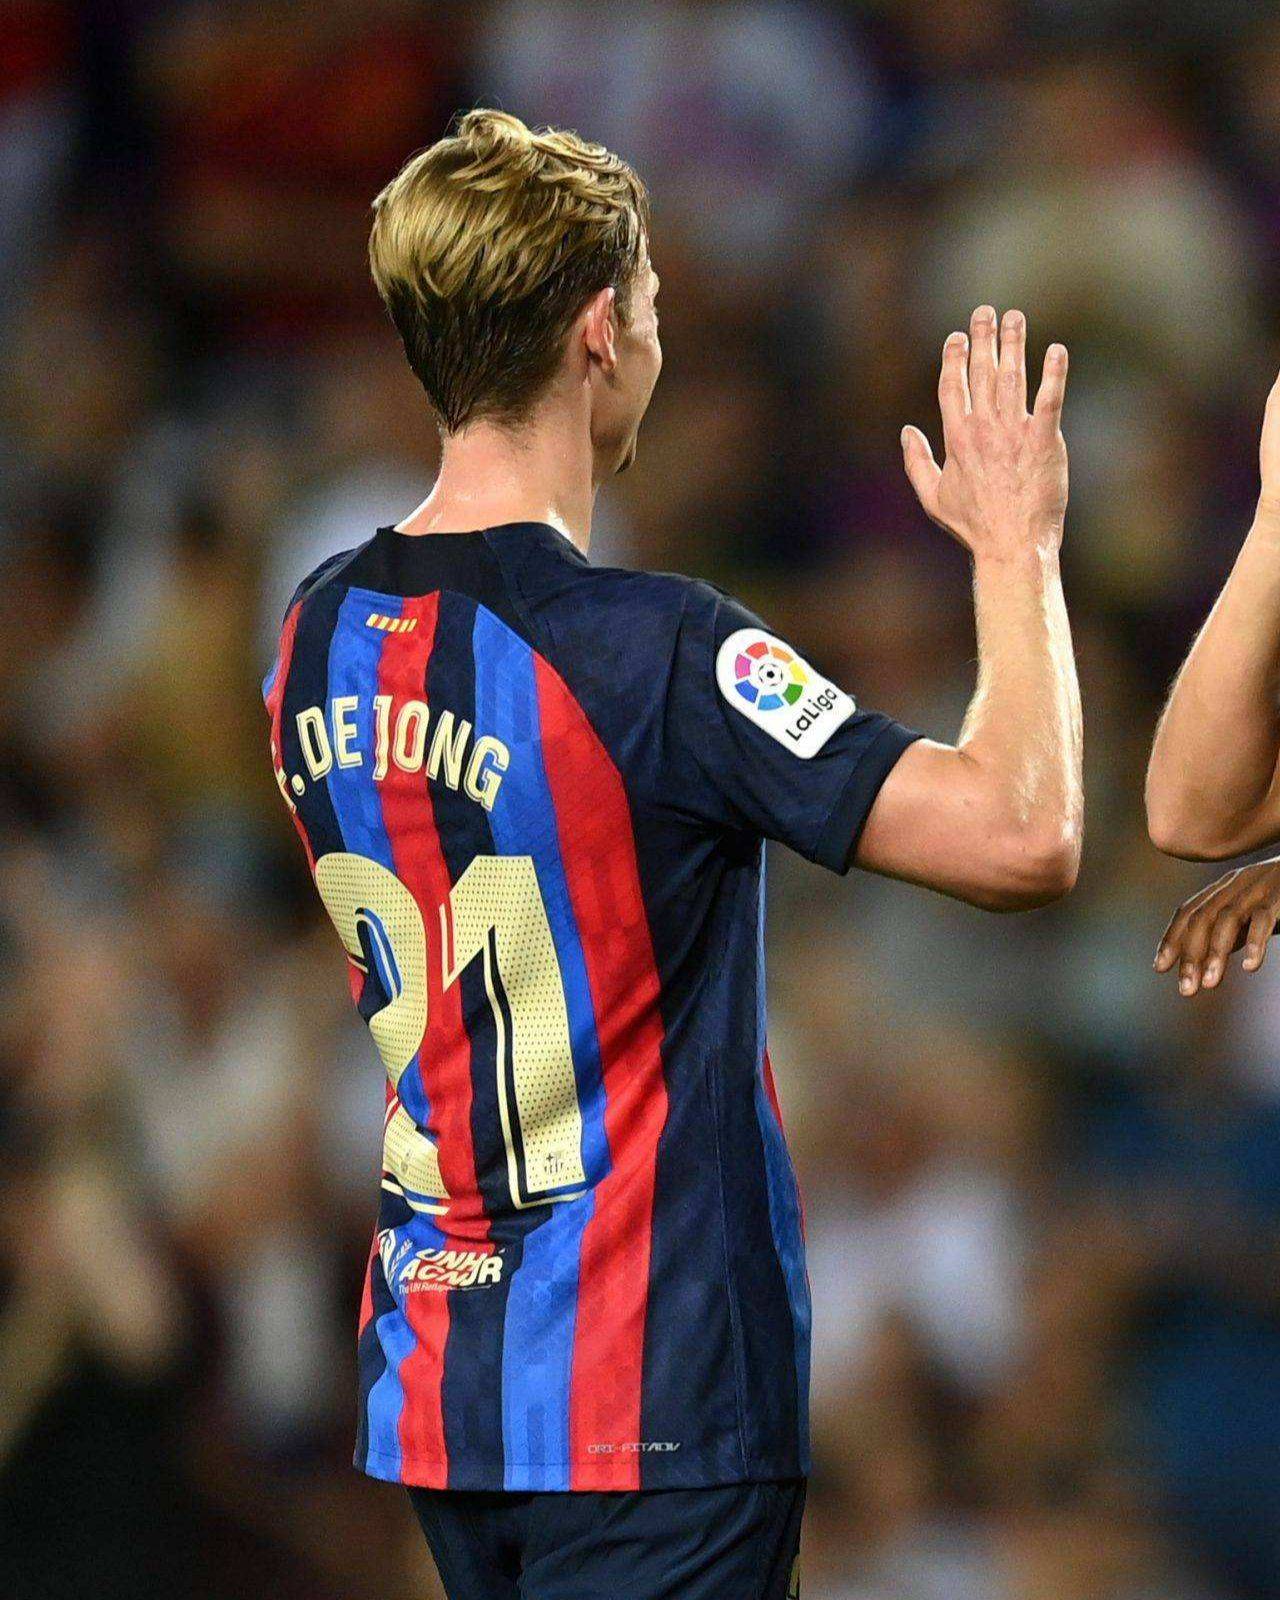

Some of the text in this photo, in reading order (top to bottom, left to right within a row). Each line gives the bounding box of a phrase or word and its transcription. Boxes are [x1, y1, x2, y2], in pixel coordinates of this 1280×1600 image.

[296, 695, 363, 782] DE
[372, 695, 511, 812] JONG
[785, 688, 837, 741] LaLiga
[315, 852, 593, 1216] 21
